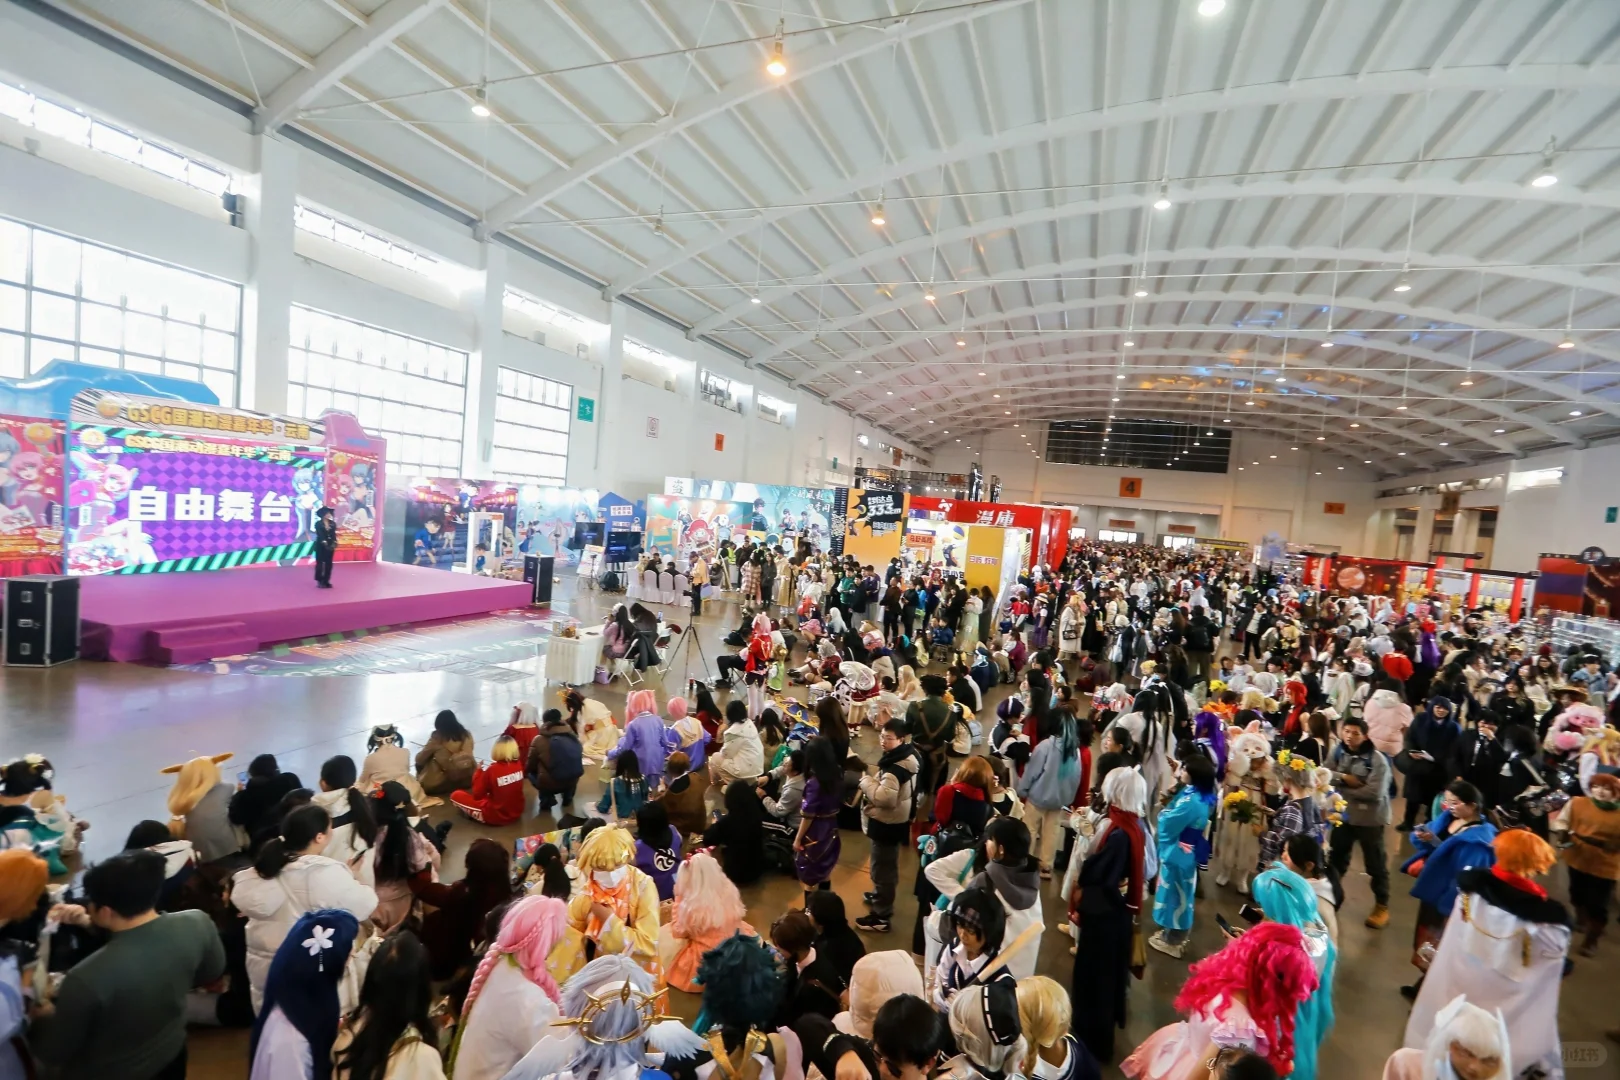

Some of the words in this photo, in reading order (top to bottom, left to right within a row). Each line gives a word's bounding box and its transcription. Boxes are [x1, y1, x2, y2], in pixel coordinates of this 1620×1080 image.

[1125, 481, 1136, 494] 4
[128, 486, 293, 523] 自由舞台
